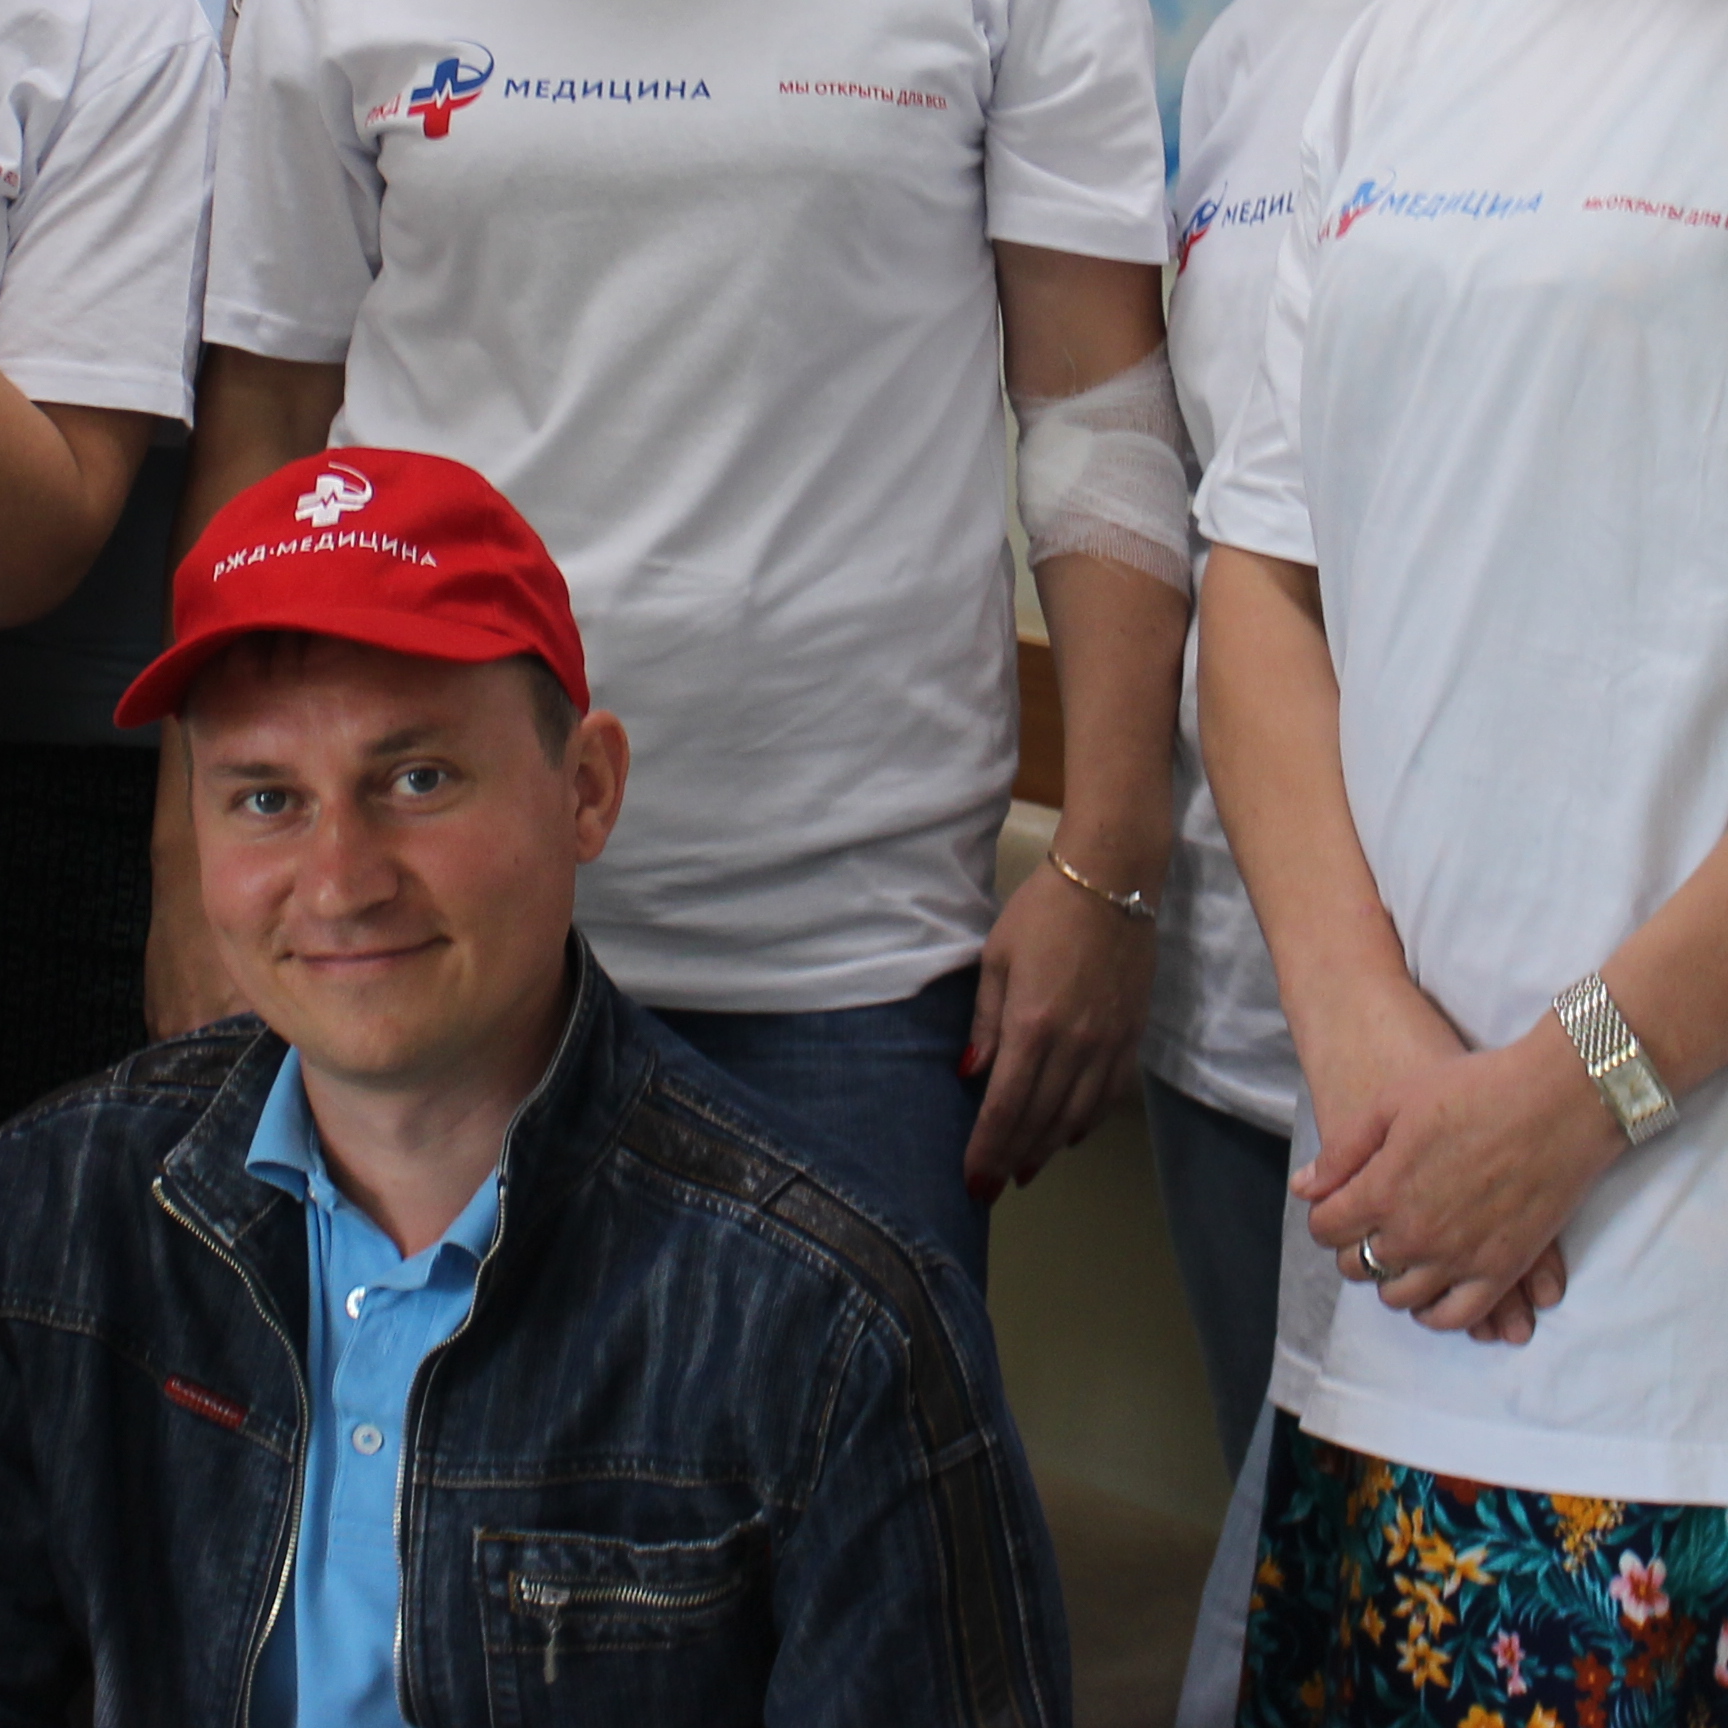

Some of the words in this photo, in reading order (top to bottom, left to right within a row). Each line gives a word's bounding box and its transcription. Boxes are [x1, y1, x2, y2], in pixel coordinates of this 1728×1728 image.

[503, 78, 712, 104] МЕДИЦИНА
[779, 80, 810, 95] МЫ
[814, 81, 895, 103] ОТКРЫТЫ
